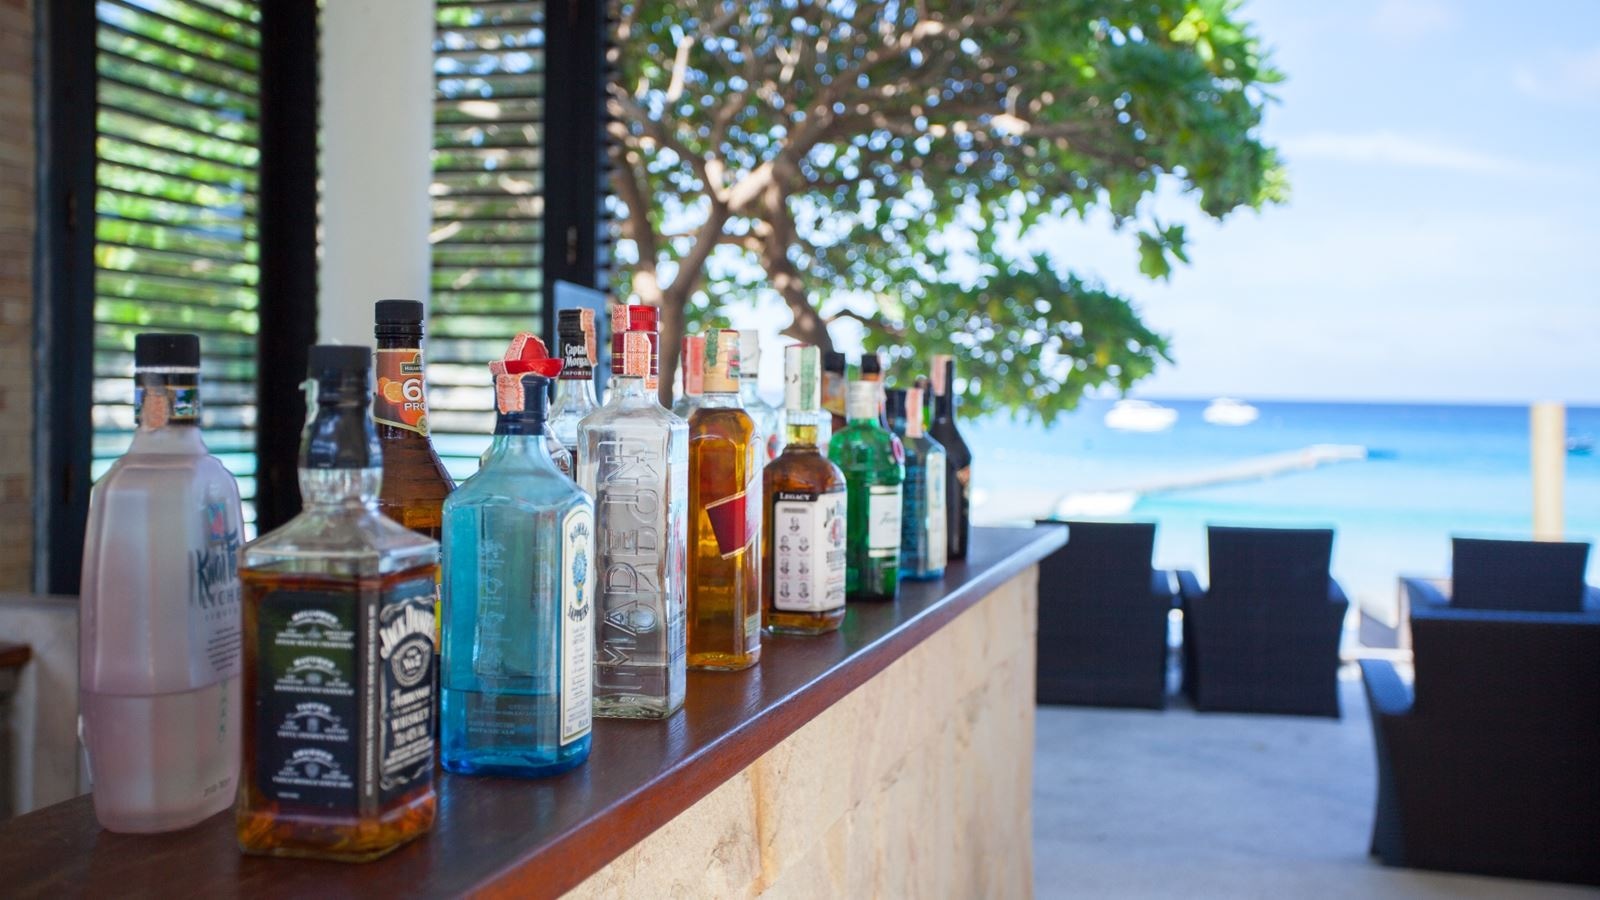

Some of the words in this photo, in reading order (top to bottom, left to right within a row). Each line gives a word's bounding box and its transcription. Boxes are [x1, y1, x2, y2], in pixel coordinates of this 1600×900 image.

[564, 356, 592, 369] Morga
[402, 378, 424, 401] 6
[604, 455, 638, 504] IN
[780, 492, 811, 501] LEGACY
[604, 561, 638, 675] MADE
[391, 707, 430, 733] WHISKEY
